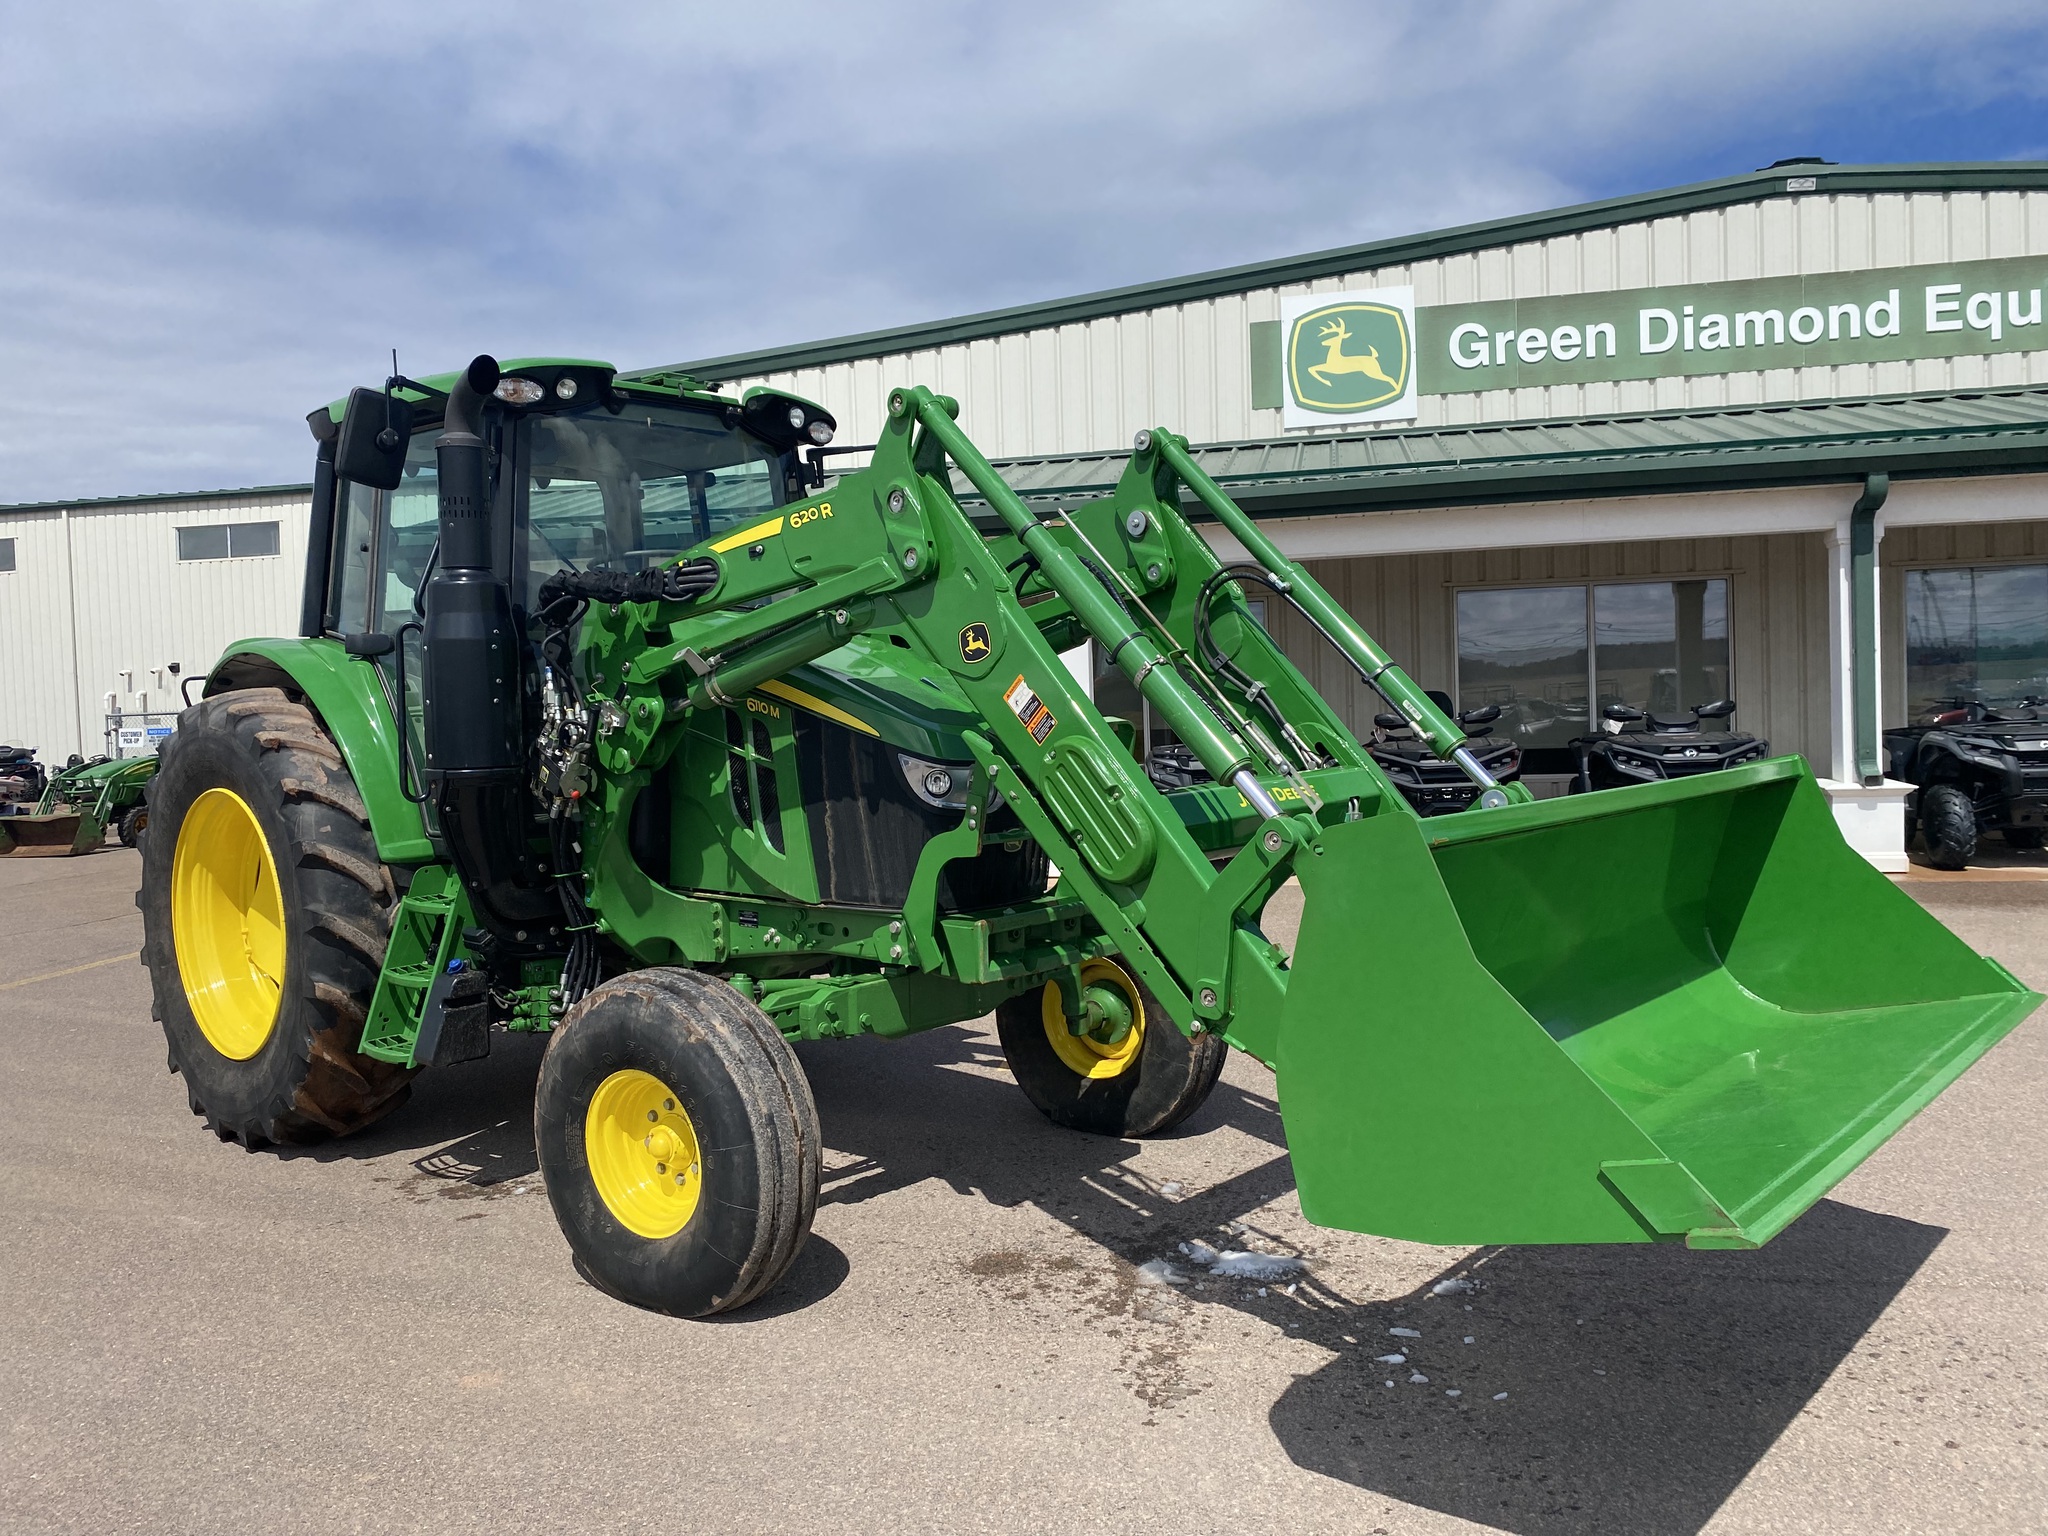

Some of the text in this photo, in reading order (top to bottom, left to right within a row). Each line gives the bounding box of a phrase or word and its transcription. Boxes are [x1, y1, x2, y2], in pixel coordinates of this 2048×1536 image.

[1449, 283, 2042, 369] Green Diamond Equ
[790, 502, 834, 528] 620 R
[746, 697, 780, 719] 6110 M
